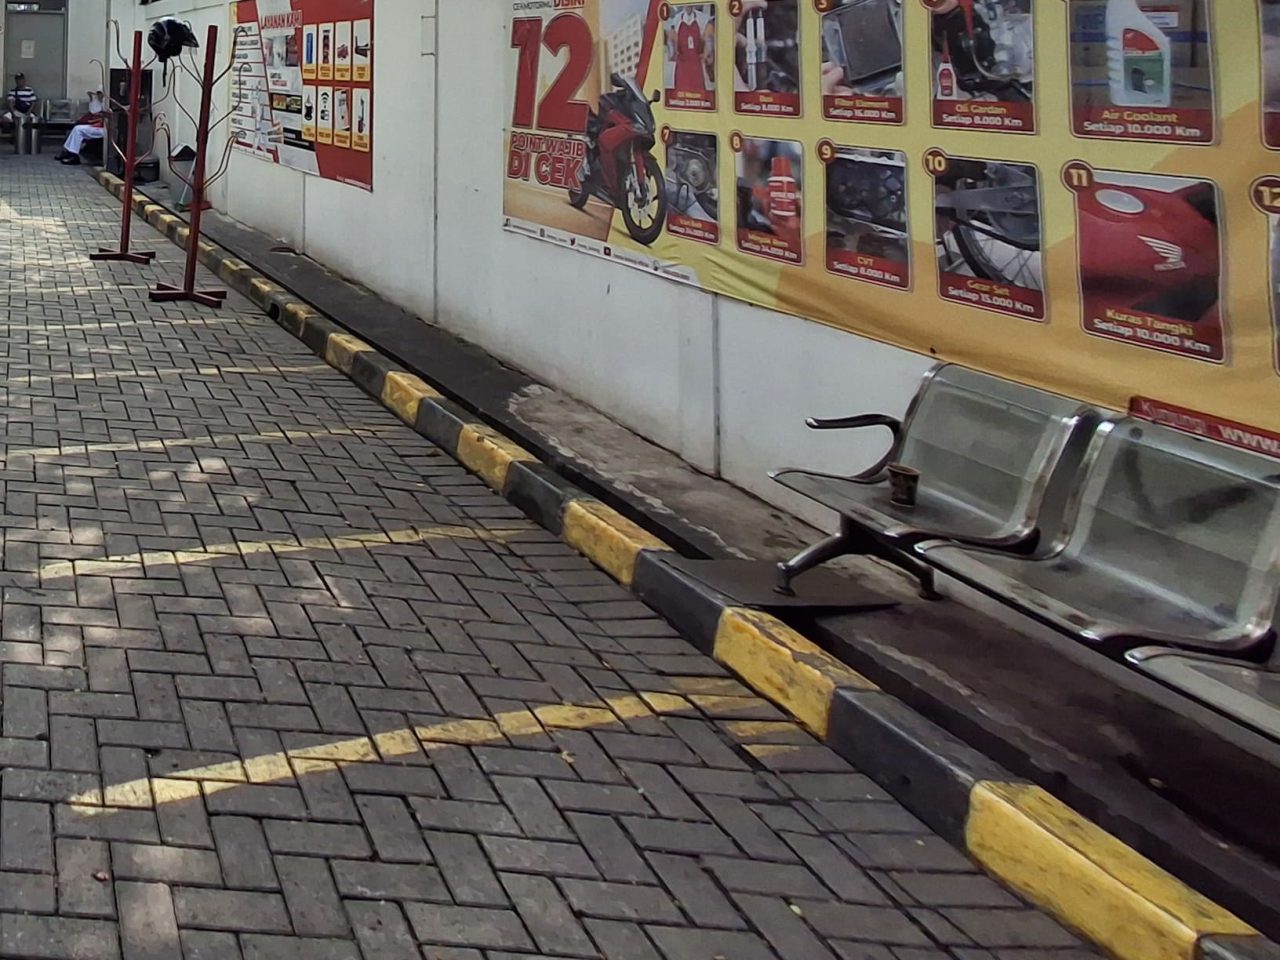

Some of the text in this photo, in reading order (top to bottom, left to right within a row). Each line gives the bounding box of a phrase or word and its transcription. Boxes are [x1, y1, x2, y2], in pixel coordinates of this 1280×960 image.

[732, 2, 740, 14] 2
[511, 12, 593, 134] 12
[830, 108, 854, 117] Setiap
[881, 110, 896, 118] Km
[956, 103, 968, 113] Oli
[1102, 109, 1178, 122] Air Coolant
[942, 114, 1022, 126] Setiap 8.000 Km
[1083, 121, 1200, 137] Setiap 10.000 Km
[511, 132, 586, 158] POINT WAJIB
[822, 146, 831, 158] 9
[507, 150, 583, 193] DI CEK
[926, 154, 946, 172] 10
[1068, 168, 1088, 187] 11
[857, 256, 874, 266] CVT
[833, 261, 858, 274] Setiap
[884, 272, 900, 282] Km
[948, 286, 1035, 314] Setiap 15.000 Km
[1106, 308, 1194, 336] Kuras Tangki
[1094, 318, 1211, 352] Setiap 10.000 Km
